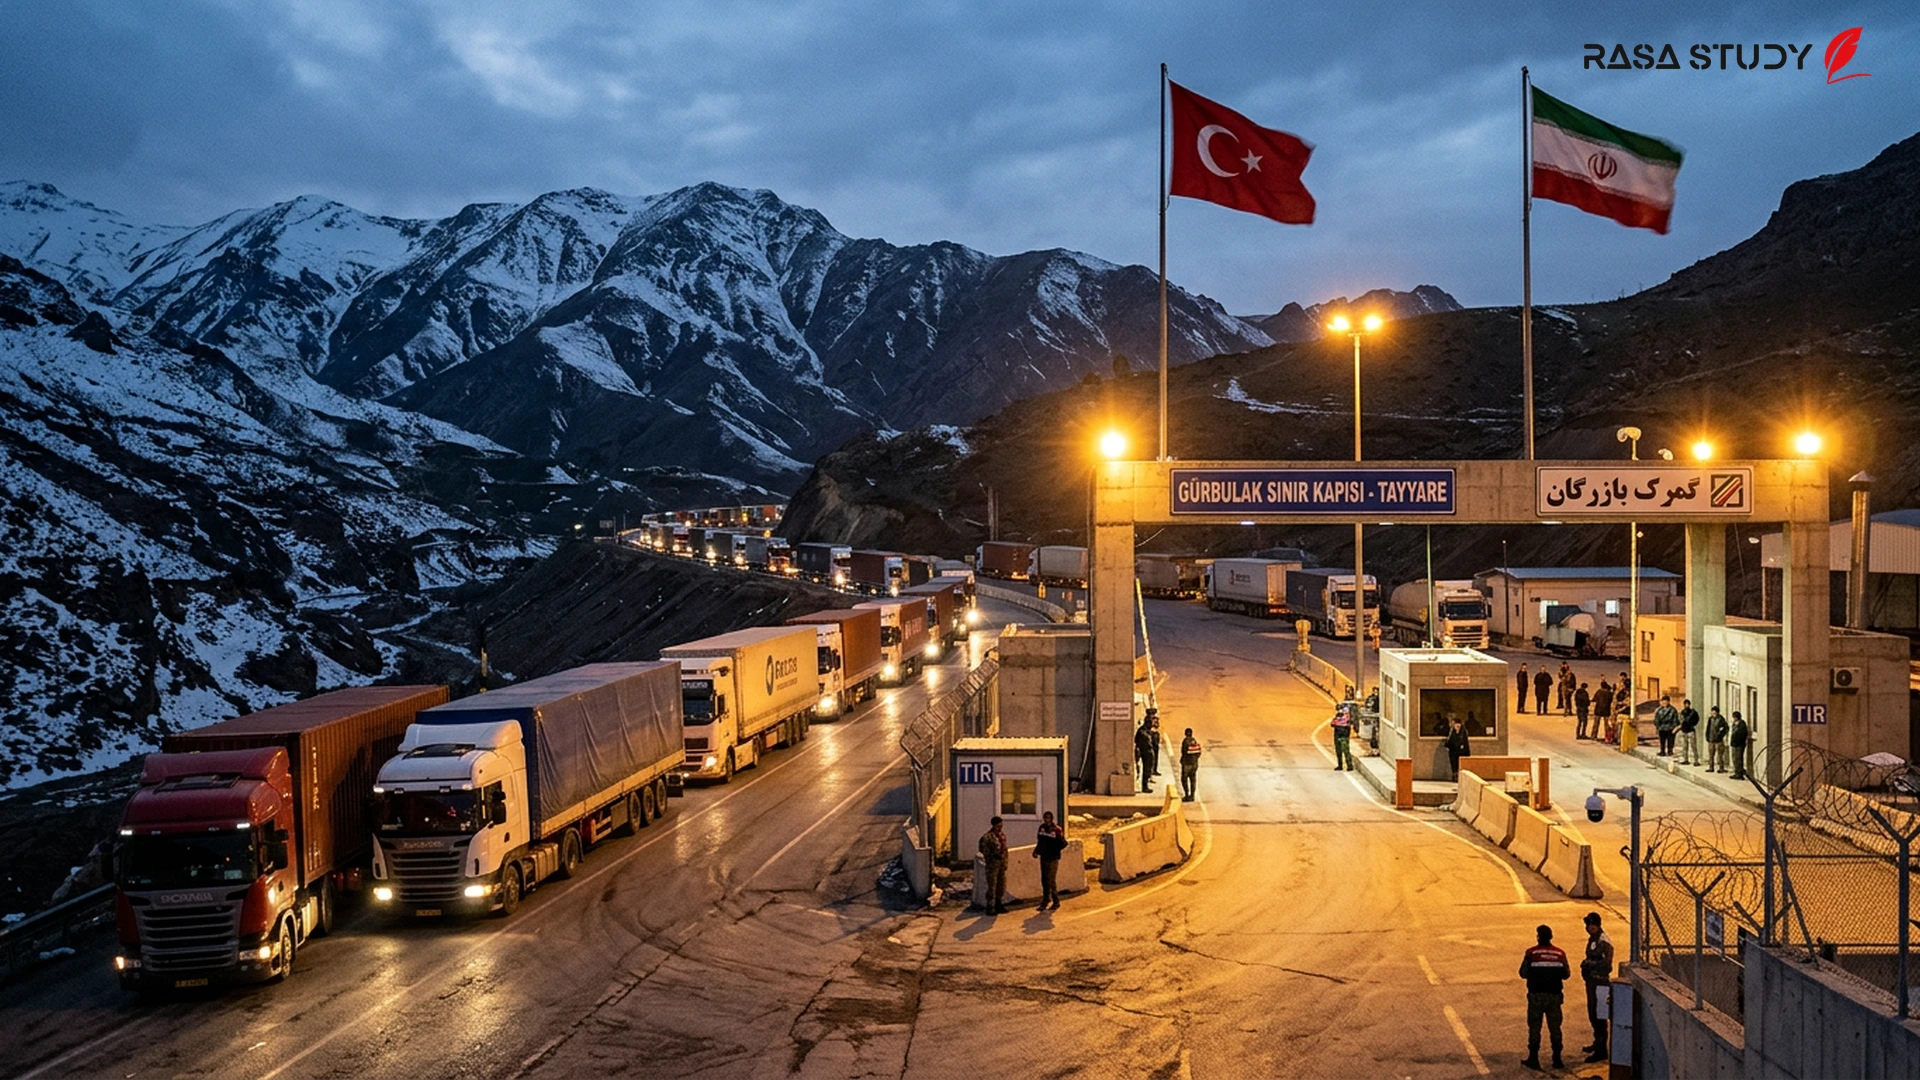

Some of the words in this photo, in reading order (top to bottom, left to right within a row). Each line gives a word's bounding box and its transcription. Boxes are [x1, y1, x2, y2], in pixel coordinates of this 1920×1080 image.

[1178, 477, 1262, 503] GÜRBULAK
[1267, 481, 1309, 503] SINIR
[1313, 481, 1364, 503] KAPISI
[1378, 481, 1447, 503] TAYYARE
[1547, 477, 1628, 507] بازرگان
[1634, 477, 1700, 507] گمرک
[1795, 705, 1825, 723] TIR
[961, 765, 992, 782] TIR
